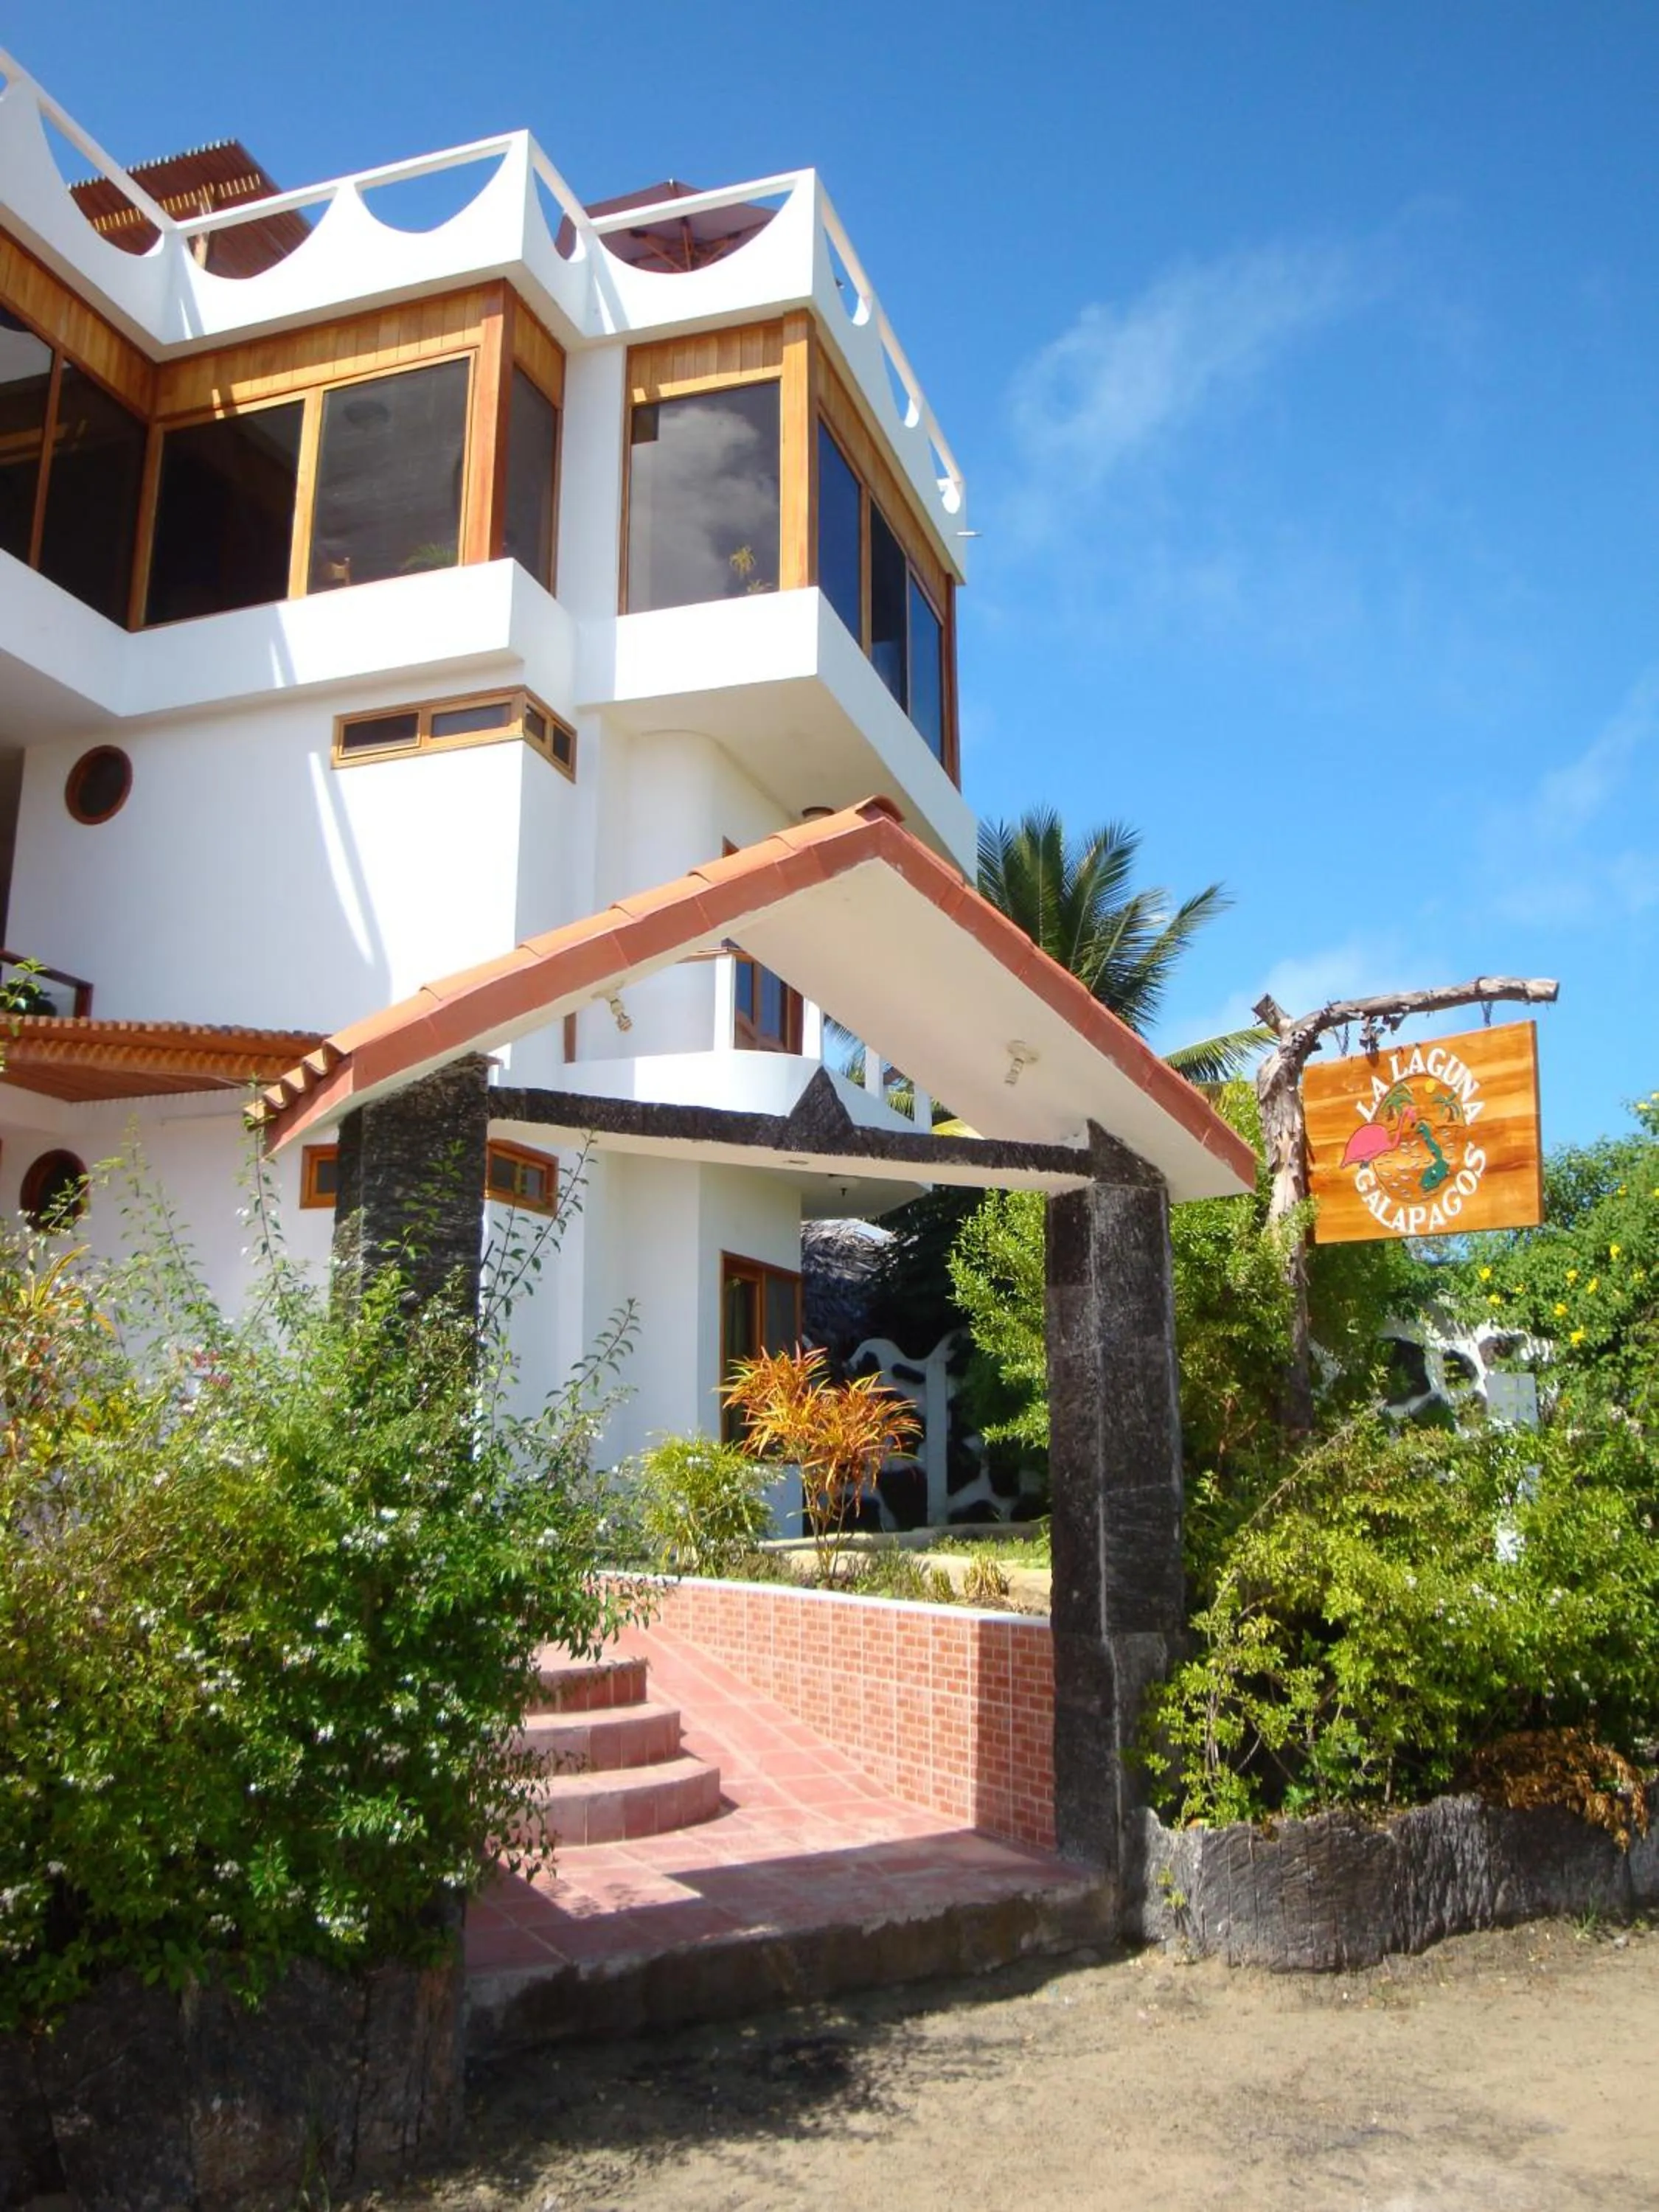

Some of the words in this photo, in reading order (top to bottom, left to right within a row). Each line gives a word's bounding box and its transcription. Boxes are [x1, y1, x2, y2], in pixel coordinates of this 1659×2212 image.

[1356, 1075, 1390, 1122] LA
[1389, 1048, 1485, 1125] LAGUNA
[1354, 1141, 1486, 1234] GALAPAGOS
